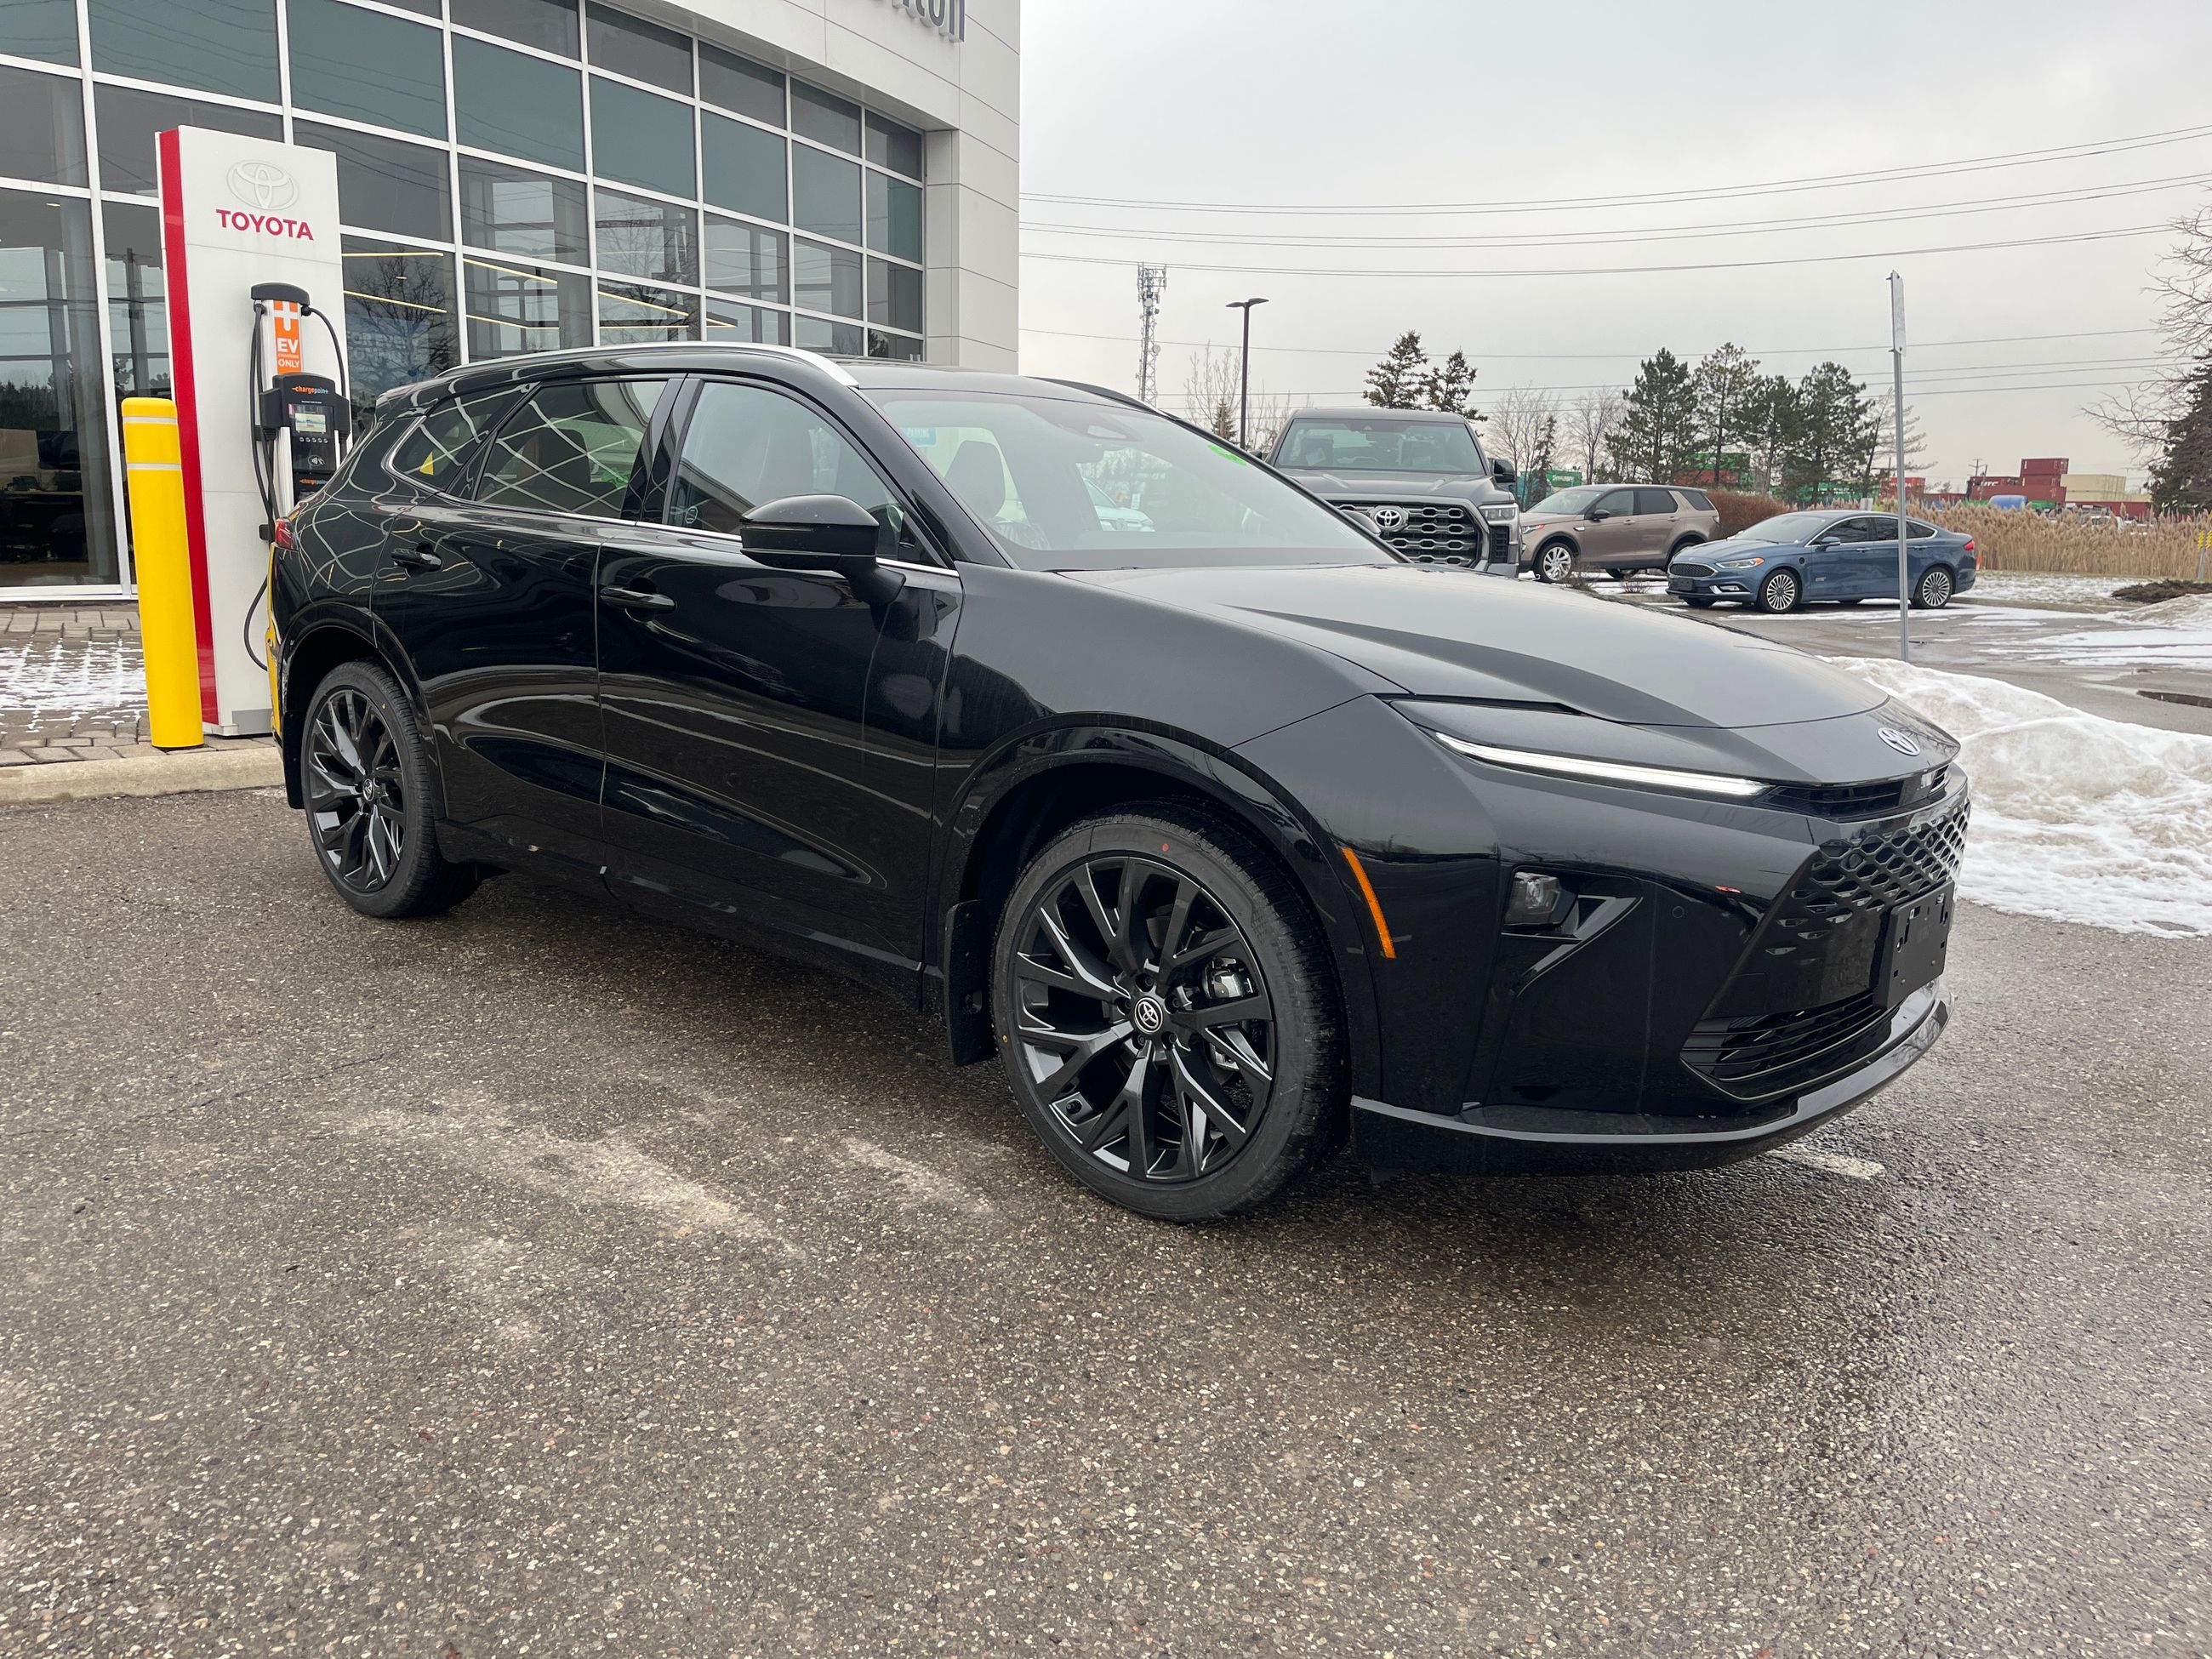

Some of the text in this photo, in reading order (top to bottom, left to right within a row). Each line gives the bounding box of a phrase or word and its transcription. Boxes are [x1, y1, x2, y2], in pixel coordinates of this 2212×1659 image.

[215, 208, 314, 241] TOYOTA
[276, 337, 299, 353] EV
[277, 358, 300, 368] ONLY
